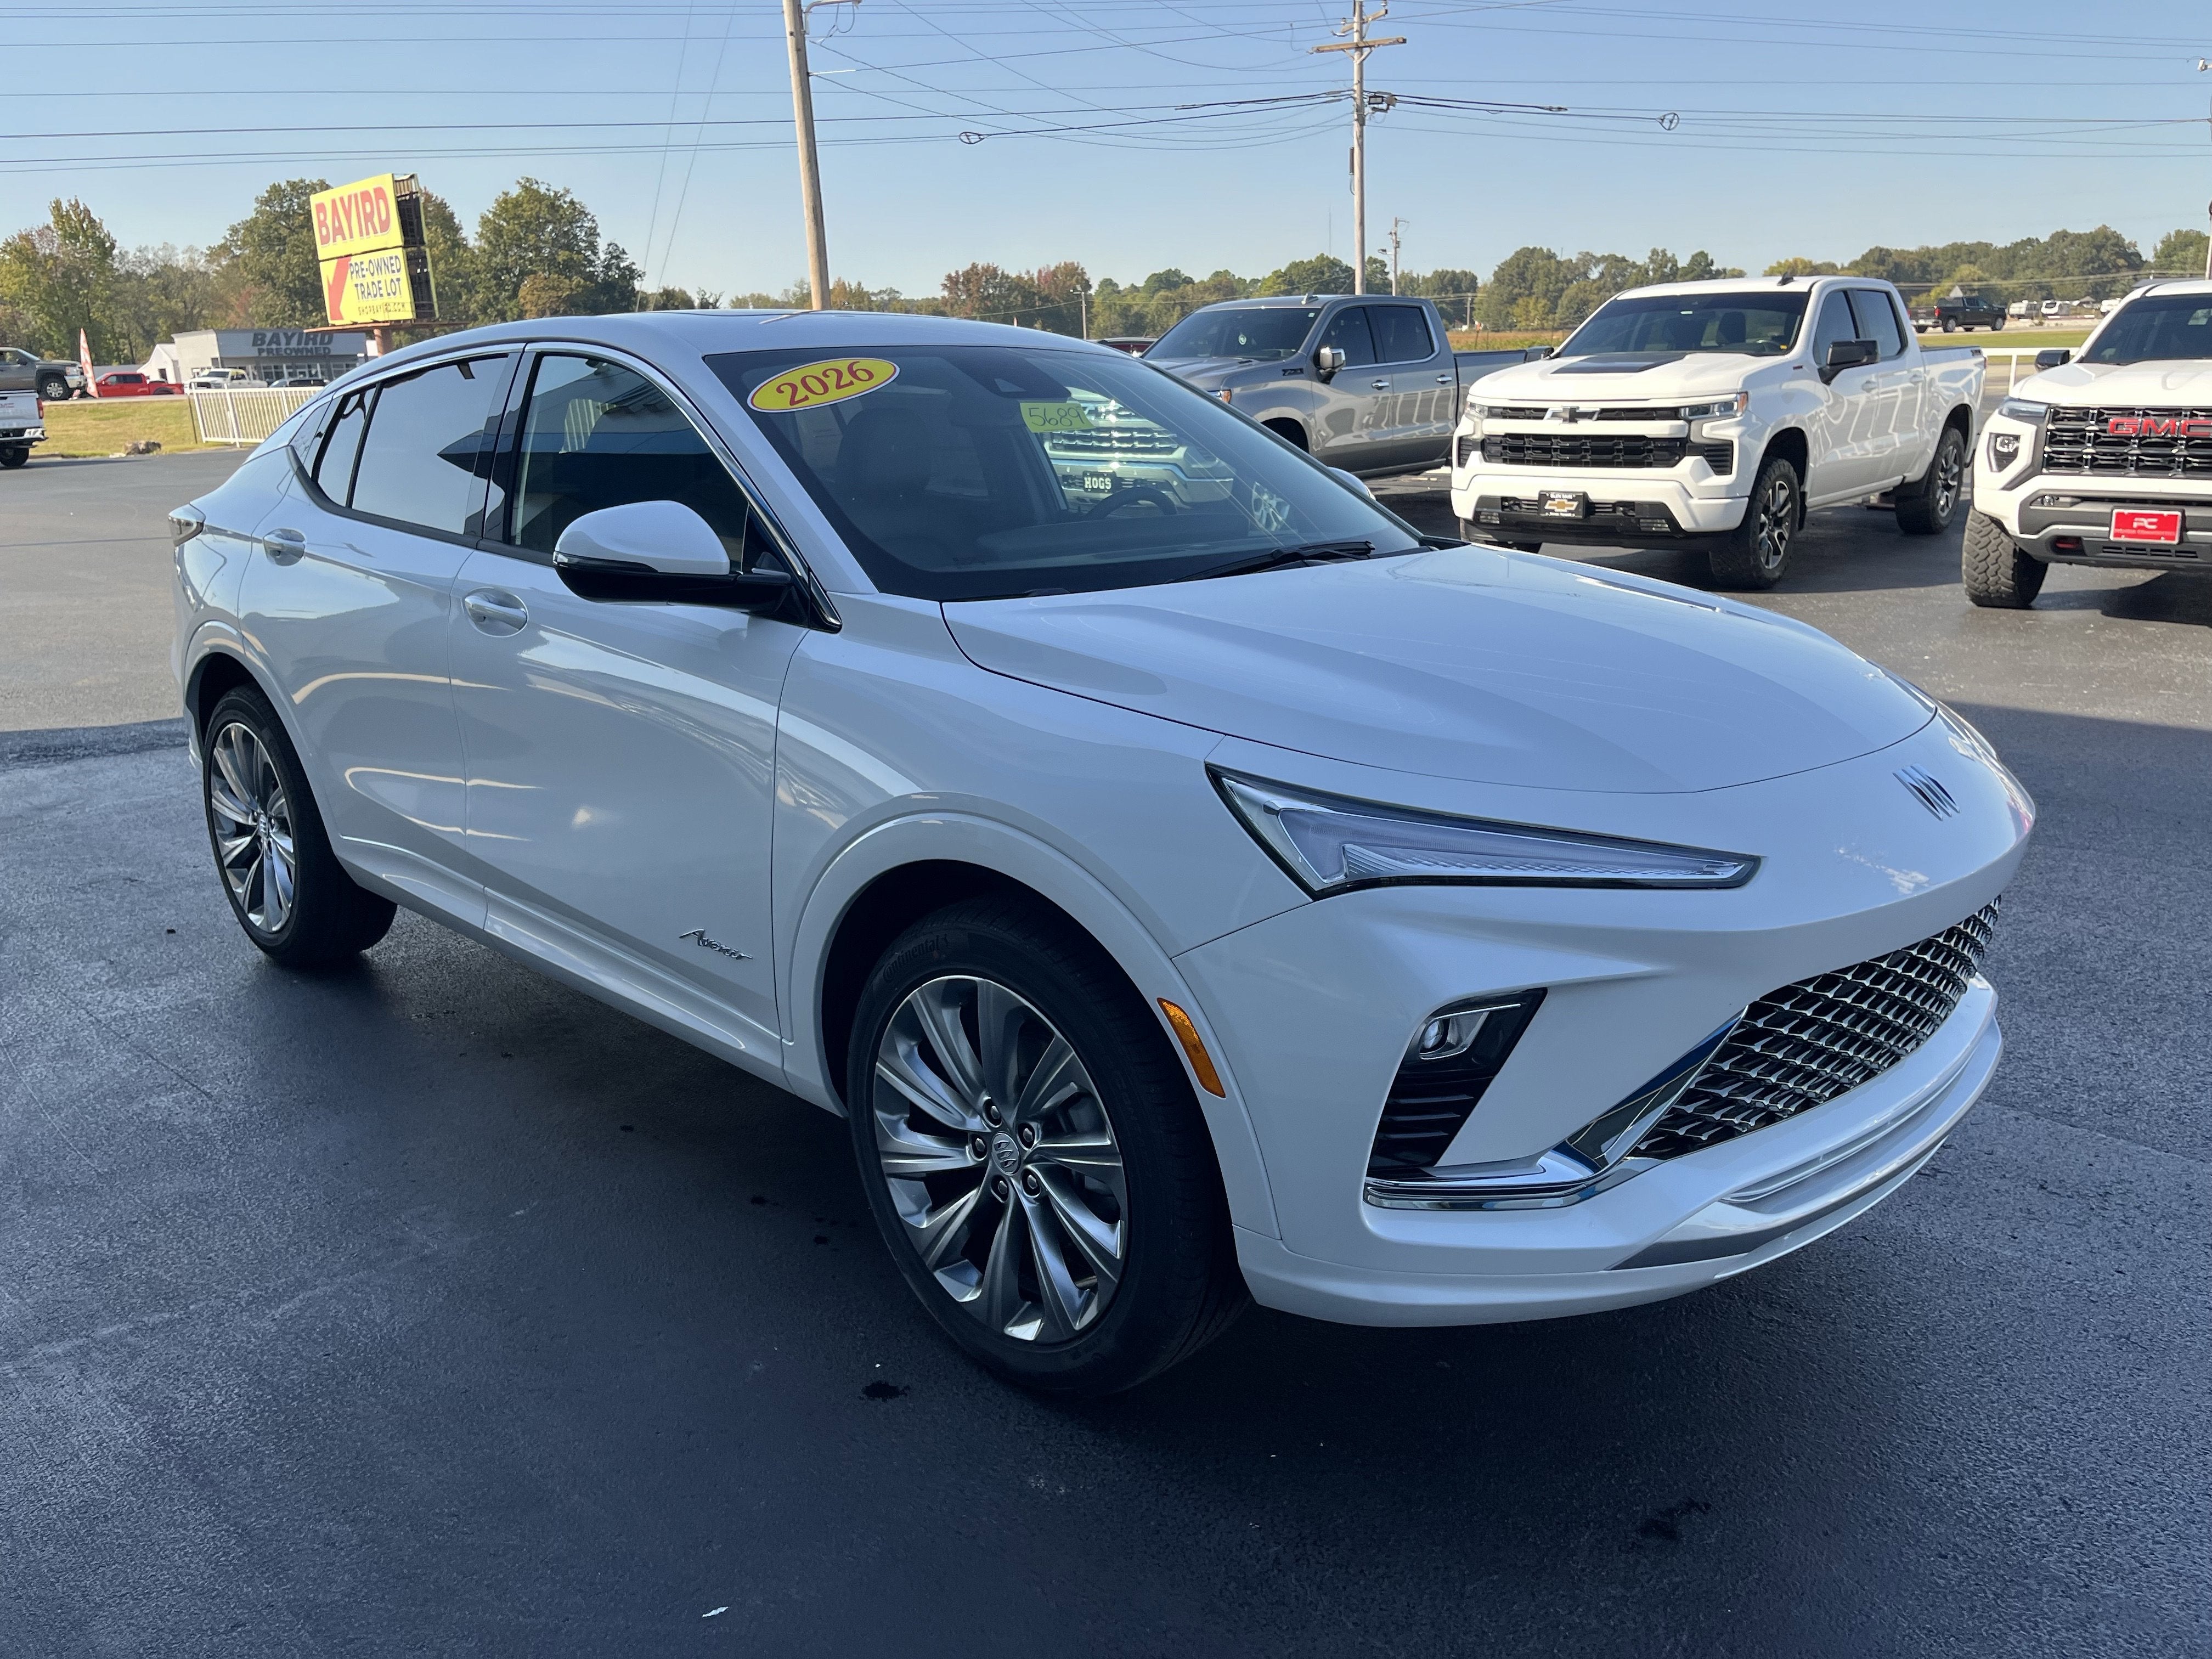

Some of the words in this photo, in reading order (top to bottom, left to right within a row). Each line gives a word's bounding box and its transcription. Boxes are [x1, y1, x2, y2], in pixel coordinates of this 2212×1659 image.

[315, 187, 391, 246] BAYIRD
[349, 255, 402, 280] PRE-OWNED
[354, 279, 384, 300] TRADE
[385, 278, 402, 297] LOT
[252, 332, 334, 347] BAYIRD
[258, 346, 331, 356] PREOWNED
[776, 360, 874, 407] 2026
[1029, 406, 1086, 427] 5689
[2108, 417, 2212, 438] GMC
[1084, 476, 1112, 490] HOGS
[679, 928, 753, 961] Avenir
[883, 934, 940, 981] Continental
